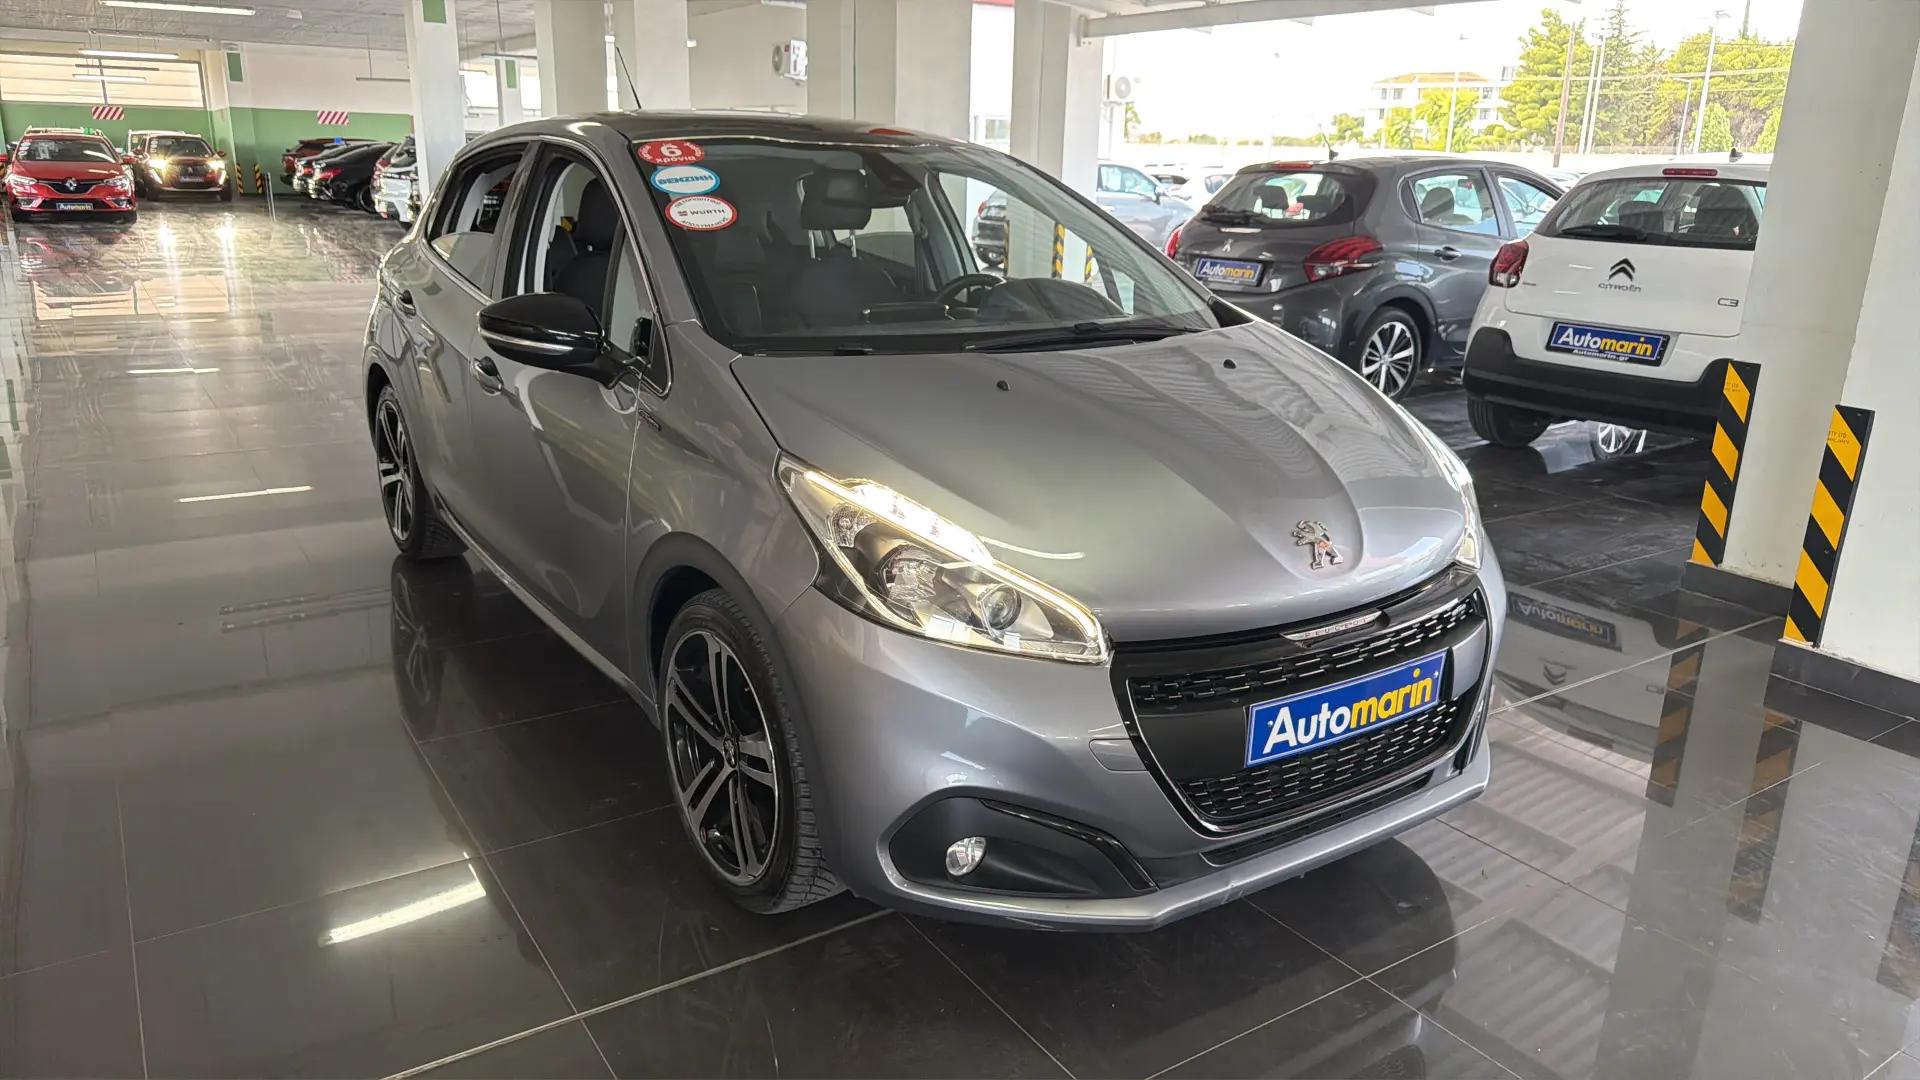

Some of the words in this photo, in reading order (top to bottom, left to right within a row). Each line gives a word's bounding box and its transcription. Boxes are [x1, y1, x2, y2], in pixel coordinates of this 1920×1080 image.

[661, 144, 682, 157] 6
[1200, 261, 1254, 278] Automarin
[1717, 297, 1739, 307] C3
[1557, 327, 1653, 357] Automarin
[1262, 668, 1433, 754] Automarin
